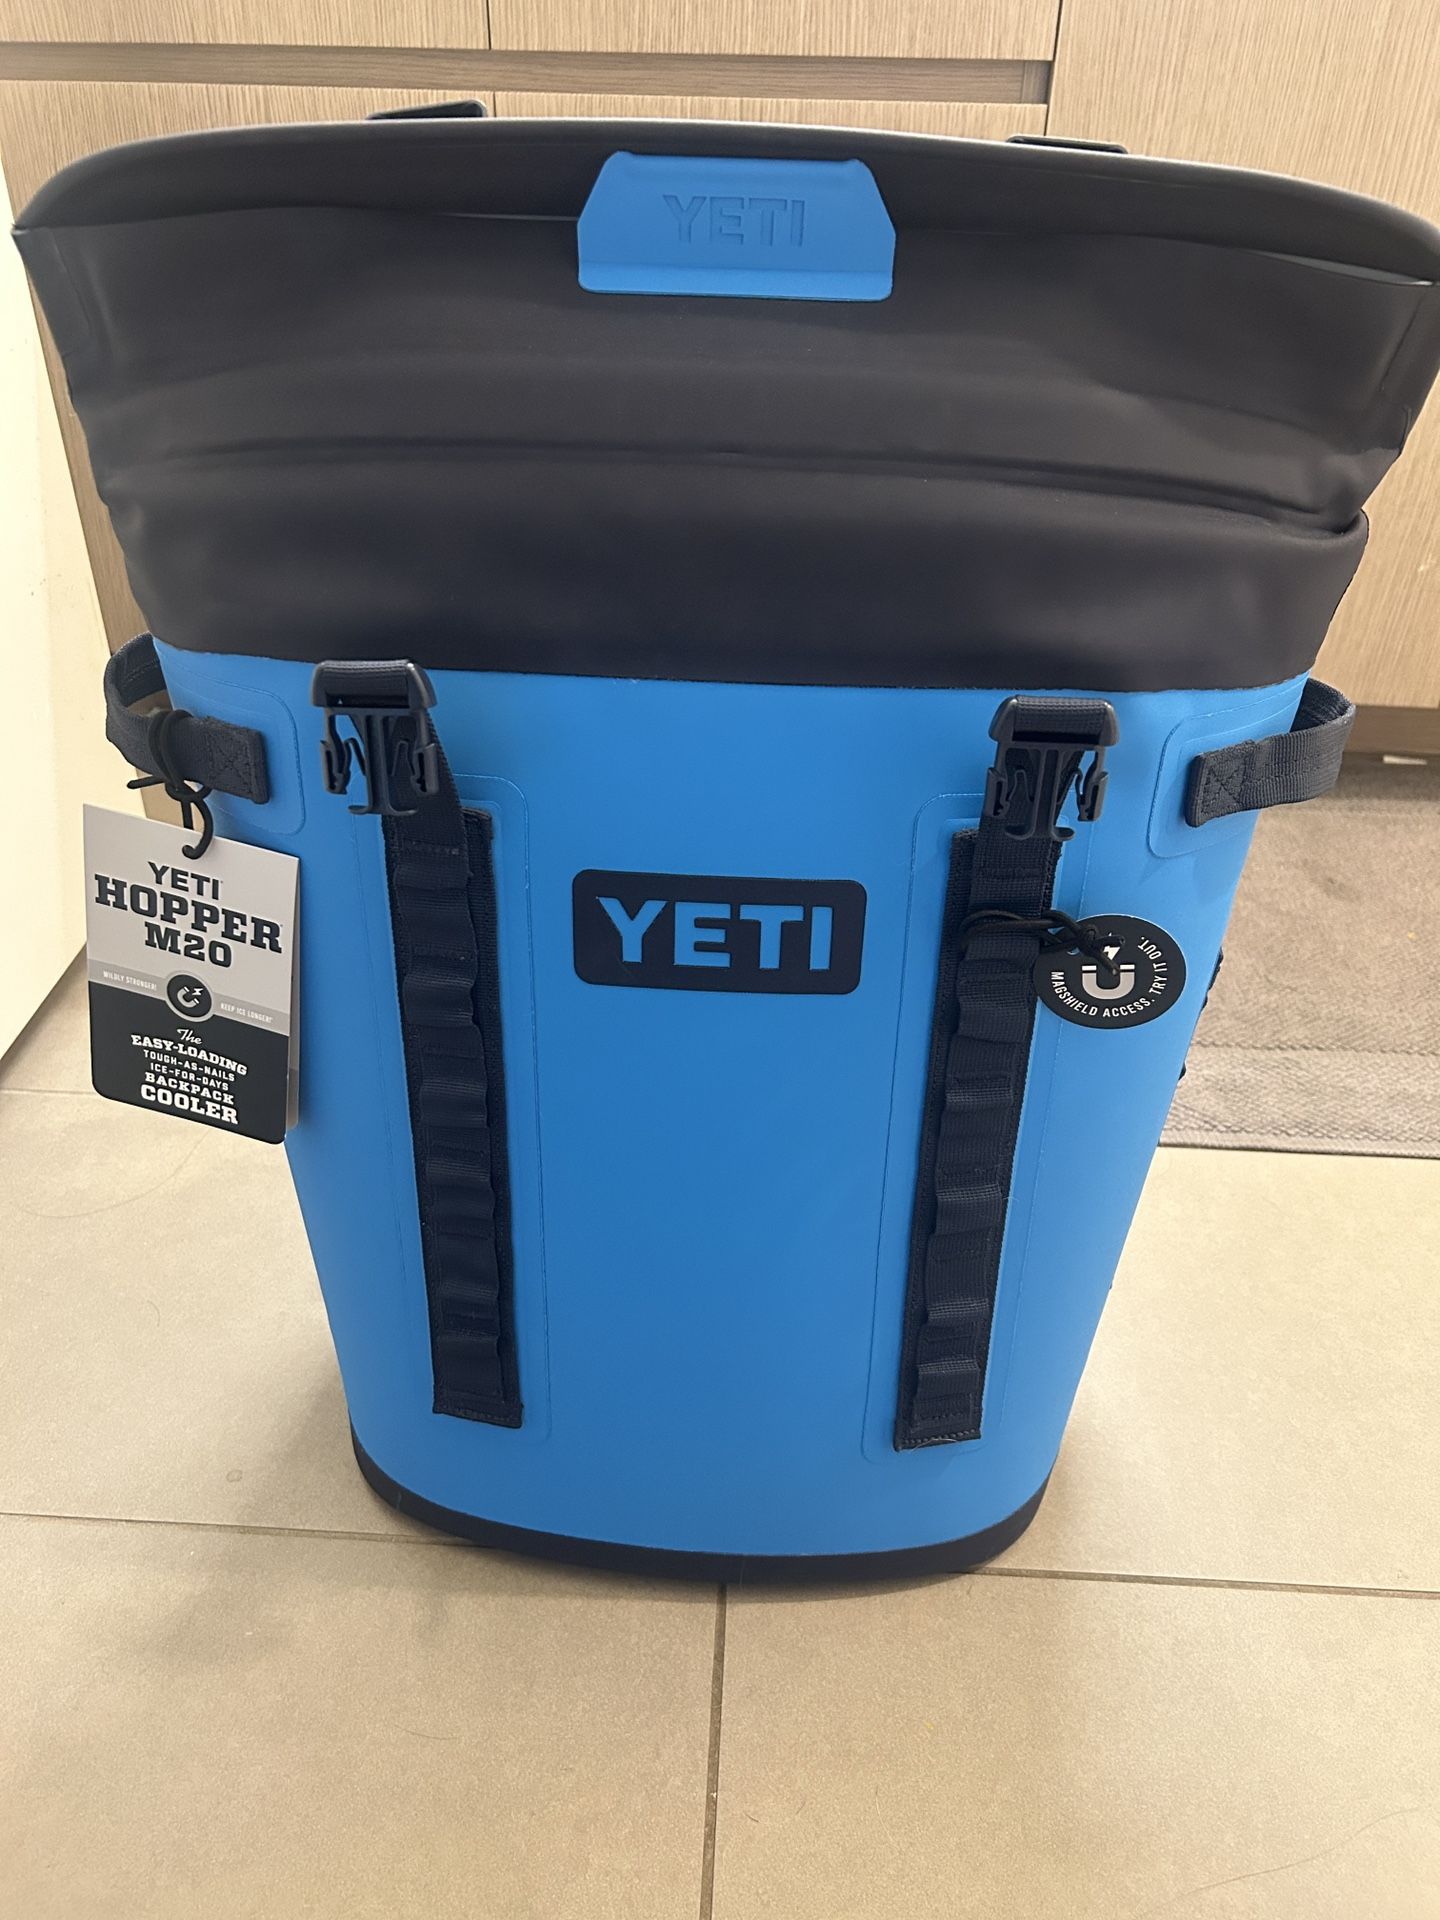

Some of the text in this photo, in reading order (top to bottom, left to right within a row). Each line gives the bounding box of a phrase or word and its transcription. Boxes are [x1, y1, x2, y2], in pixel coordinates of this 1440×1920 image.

[662, 194, 805, 247] YETI
[147, 861, 220, 900] YETI
[94, 873, 283, 954] HOPPER
[595, 895, 834, 971] YETI
[145, 921, 232, 968] M20
[1148, 975, 1168, 995] TRY
[1152, 962, 1168, 972] IT
[1051, 971, 1098, 1017] MAGSHIELD
[130, 1034, 248, 1076] EASY-LOADING
[176, 1028, 203, 1045] The
[143, 1049, 235, 1082] TOUGH-AS-NAILS
[150, 1062, 229, 1091] ICE-FOR-DAYS
[140, 1084, 239, 1125] COOLER
[145, 1071, 235, 1105] BACKPACK
